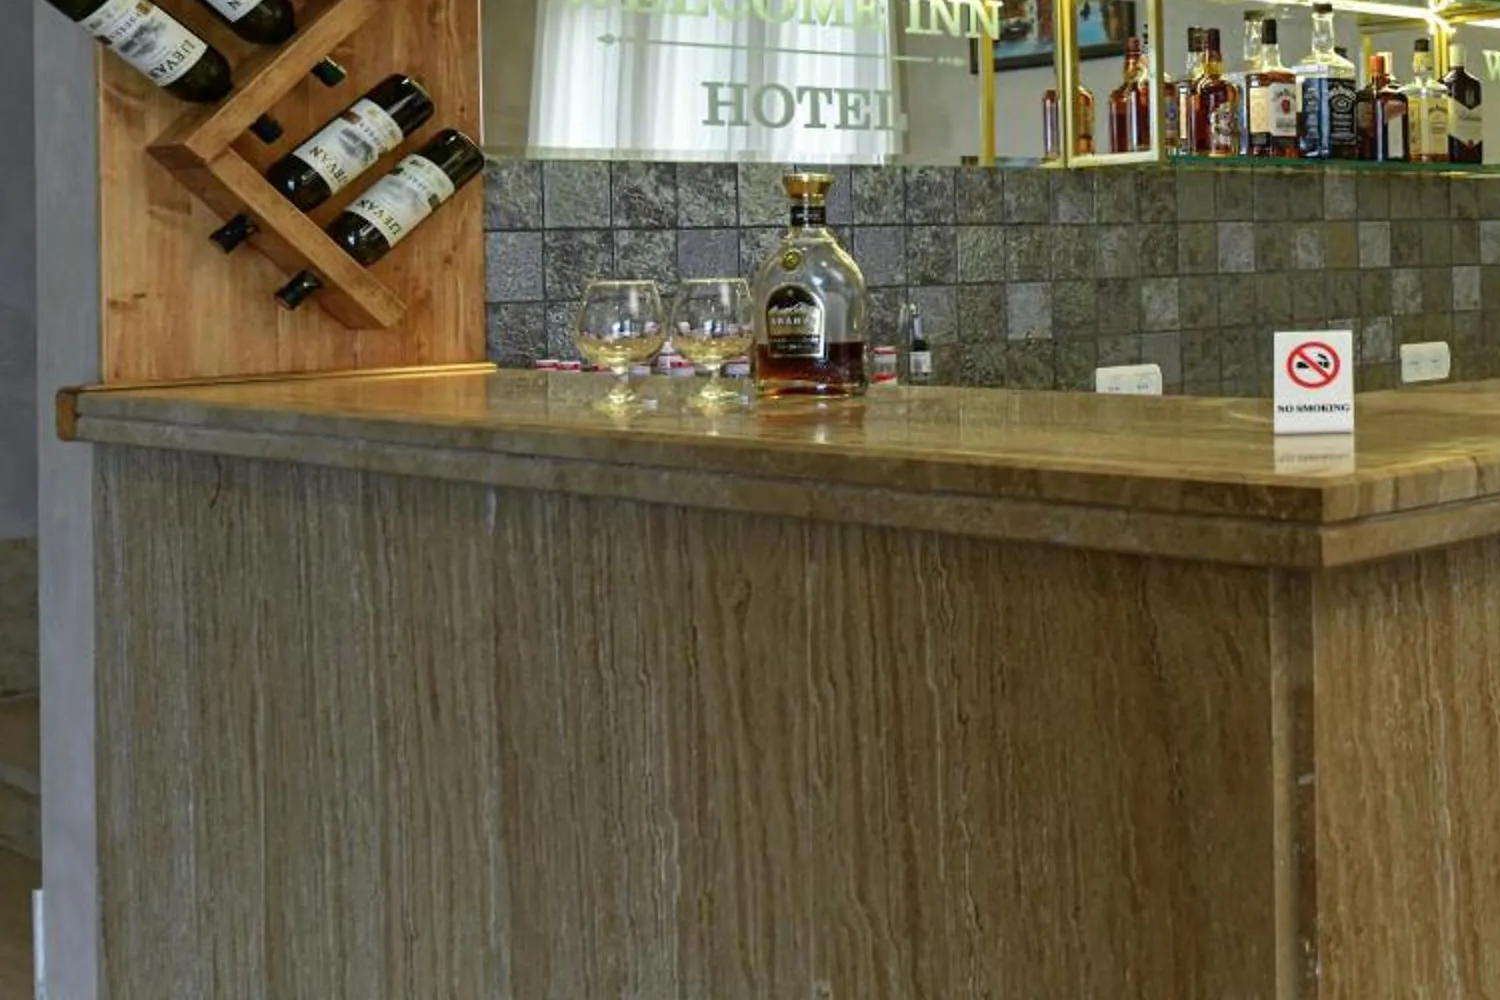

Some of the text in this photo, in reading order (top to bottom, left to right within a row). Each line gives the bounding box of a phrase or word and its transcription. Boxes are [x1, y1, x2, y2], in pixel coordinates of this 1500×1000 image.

[700, 81, 910, 134] HOTEL
[1277, 403, 1350, 414] NO SMOKING
